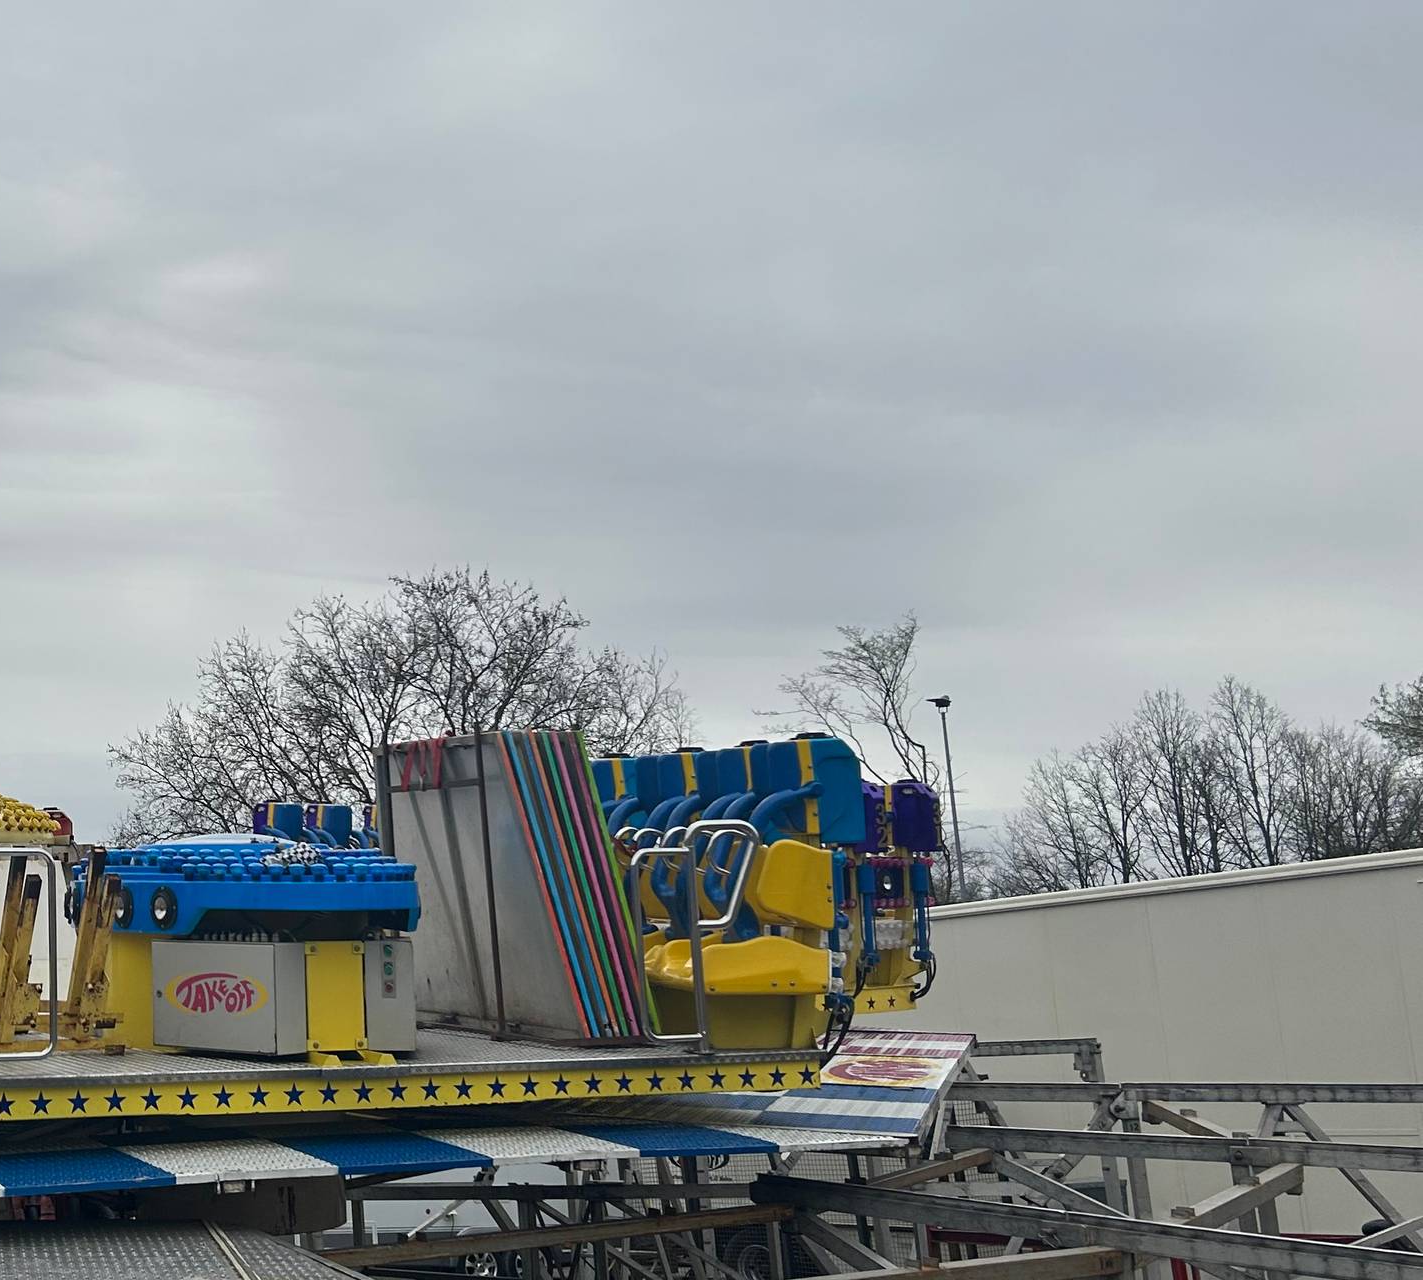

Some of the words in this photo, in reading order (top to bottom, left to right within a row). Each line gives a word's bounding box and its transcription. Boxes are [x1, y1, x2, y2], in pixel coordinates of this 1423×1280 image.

[875, 803, 888, 849] 32
[176, 973, 238, 1013] TAKE
[224, 980, 255, 1013] OFF
